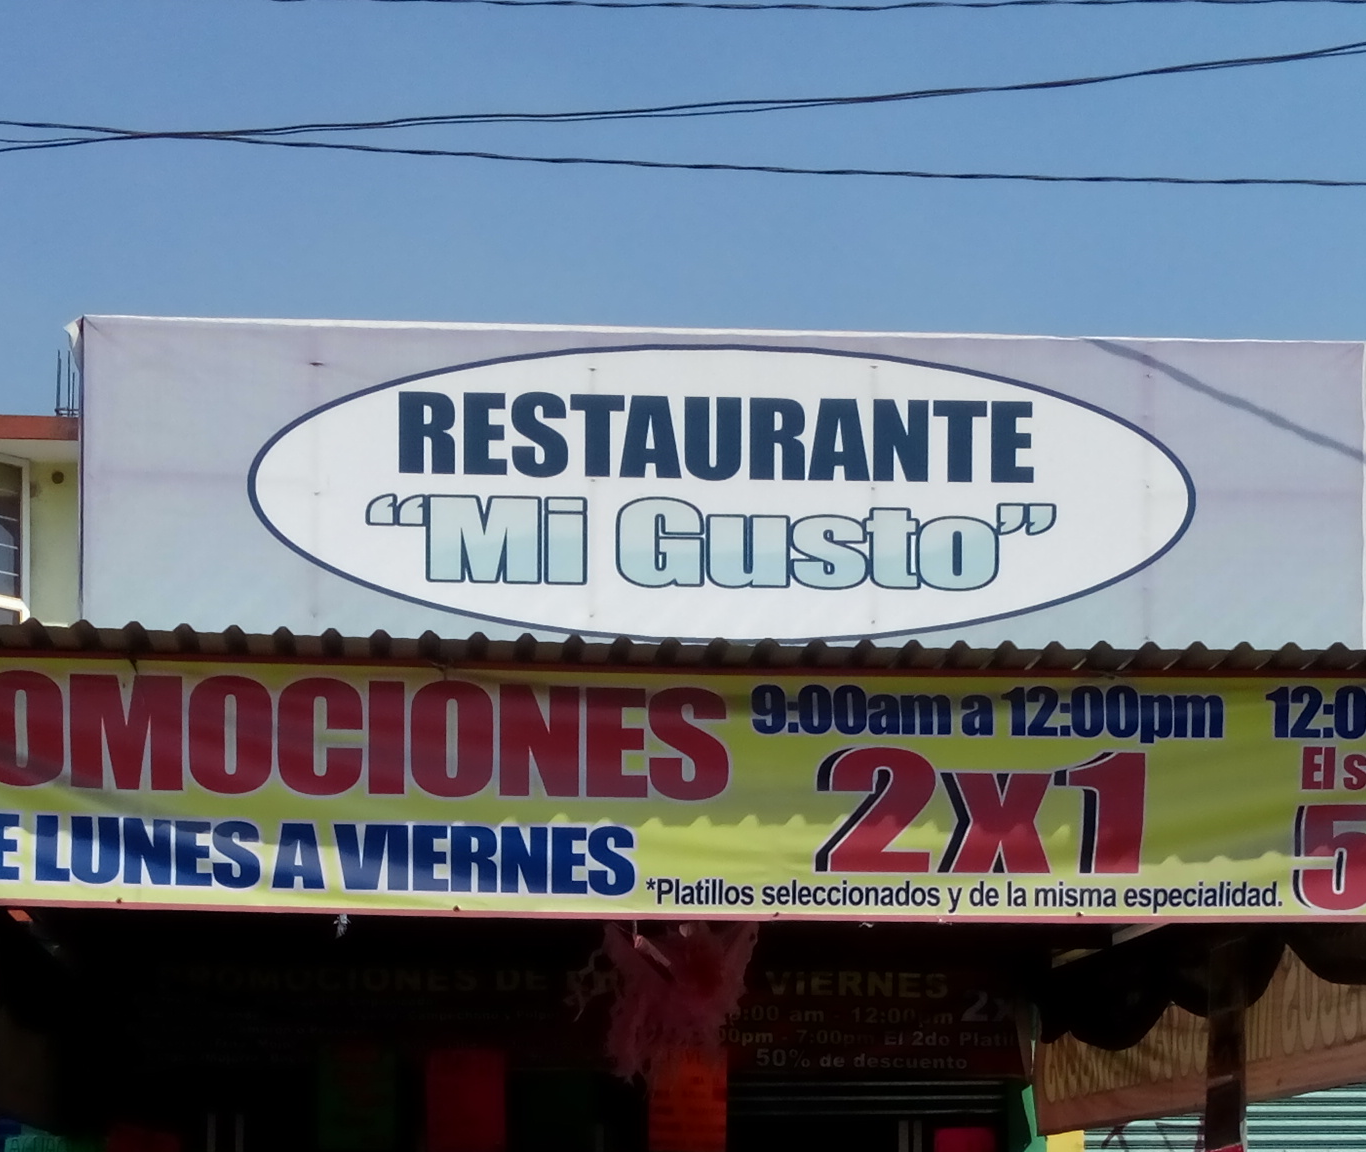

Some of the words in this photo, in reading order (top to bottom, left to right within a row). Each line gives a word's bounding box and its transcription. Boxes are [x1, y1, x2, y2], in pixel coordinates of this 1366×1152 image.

[398, 390, 1035, 484] RESTAURANTE
[750, 684, 952, 736] 9:00am
[961, 693, 994, 736] a
[1003, 685, 1224, 744] 12:00pm
[1301, 746, 1334, 790] El
[815, 746, 1147, 874] 2x1
[35, 814, 262, 889] LUNES
[271, 823, 325, 889] A
[333, 824, 636, 896] VIERNES
[761, 879, 940, 907] seleccionados
[946, 886, 962, 914] y
[969, 881, 1000, 907] de
[1007, 881, 1028, 907] la
[1034, 881, 1117, 907] misma
[1123, 881, 1283, 914] especialidad.
[765, 971, 949, 998] VIERNES
[789, 1009, 825, 1023] am
[884, 1032, 904, 1047] El
[912, 1030, 951, 1047] 2do
[756, 1049, 811, 1068] 50%
[819, 1053, 846, 1069] de
[854, 1053, 968, 1070] descuento
